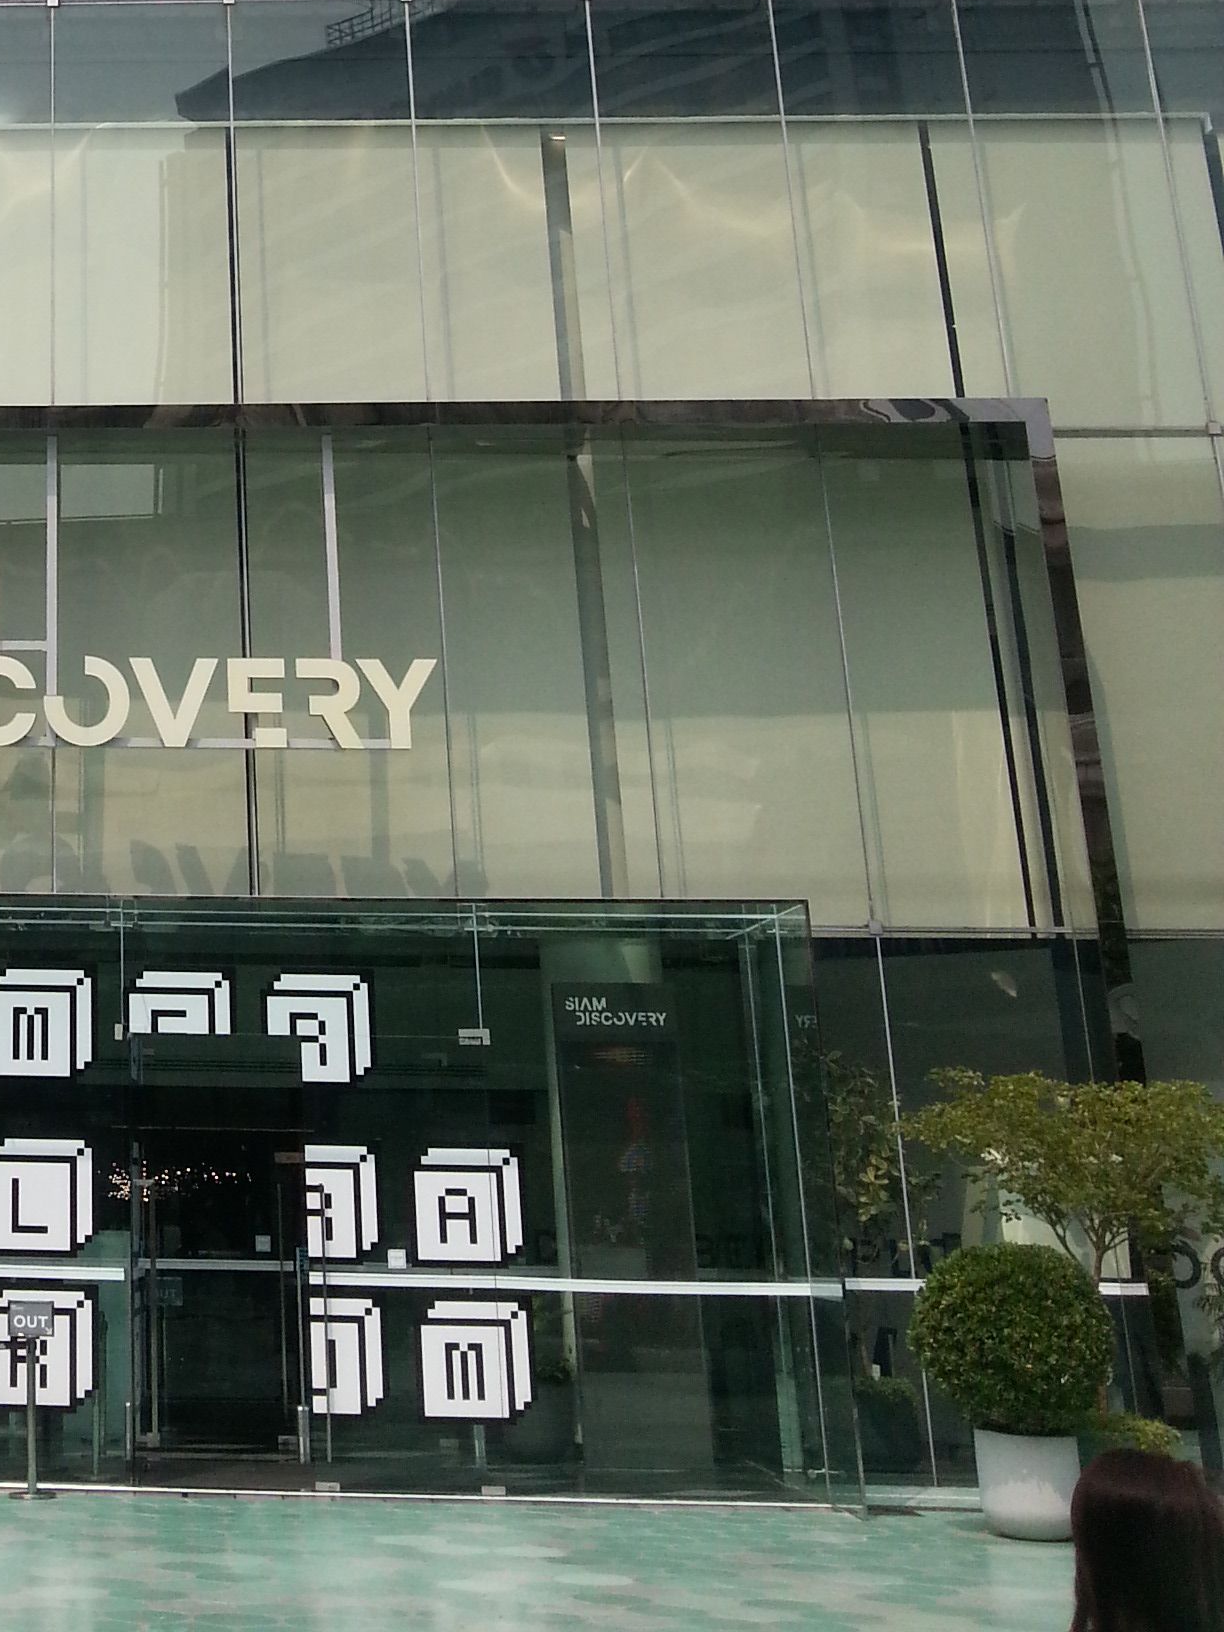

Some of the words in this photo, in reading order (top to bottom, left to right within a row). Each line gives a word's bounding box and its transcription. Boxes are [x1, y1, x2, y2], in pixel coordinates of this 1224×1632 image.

[564, 995, 607, 1011] SIAM
[574, 1011, 668, 1026] DISCOVERY
[13, 1314, 49, 1329] OUT
